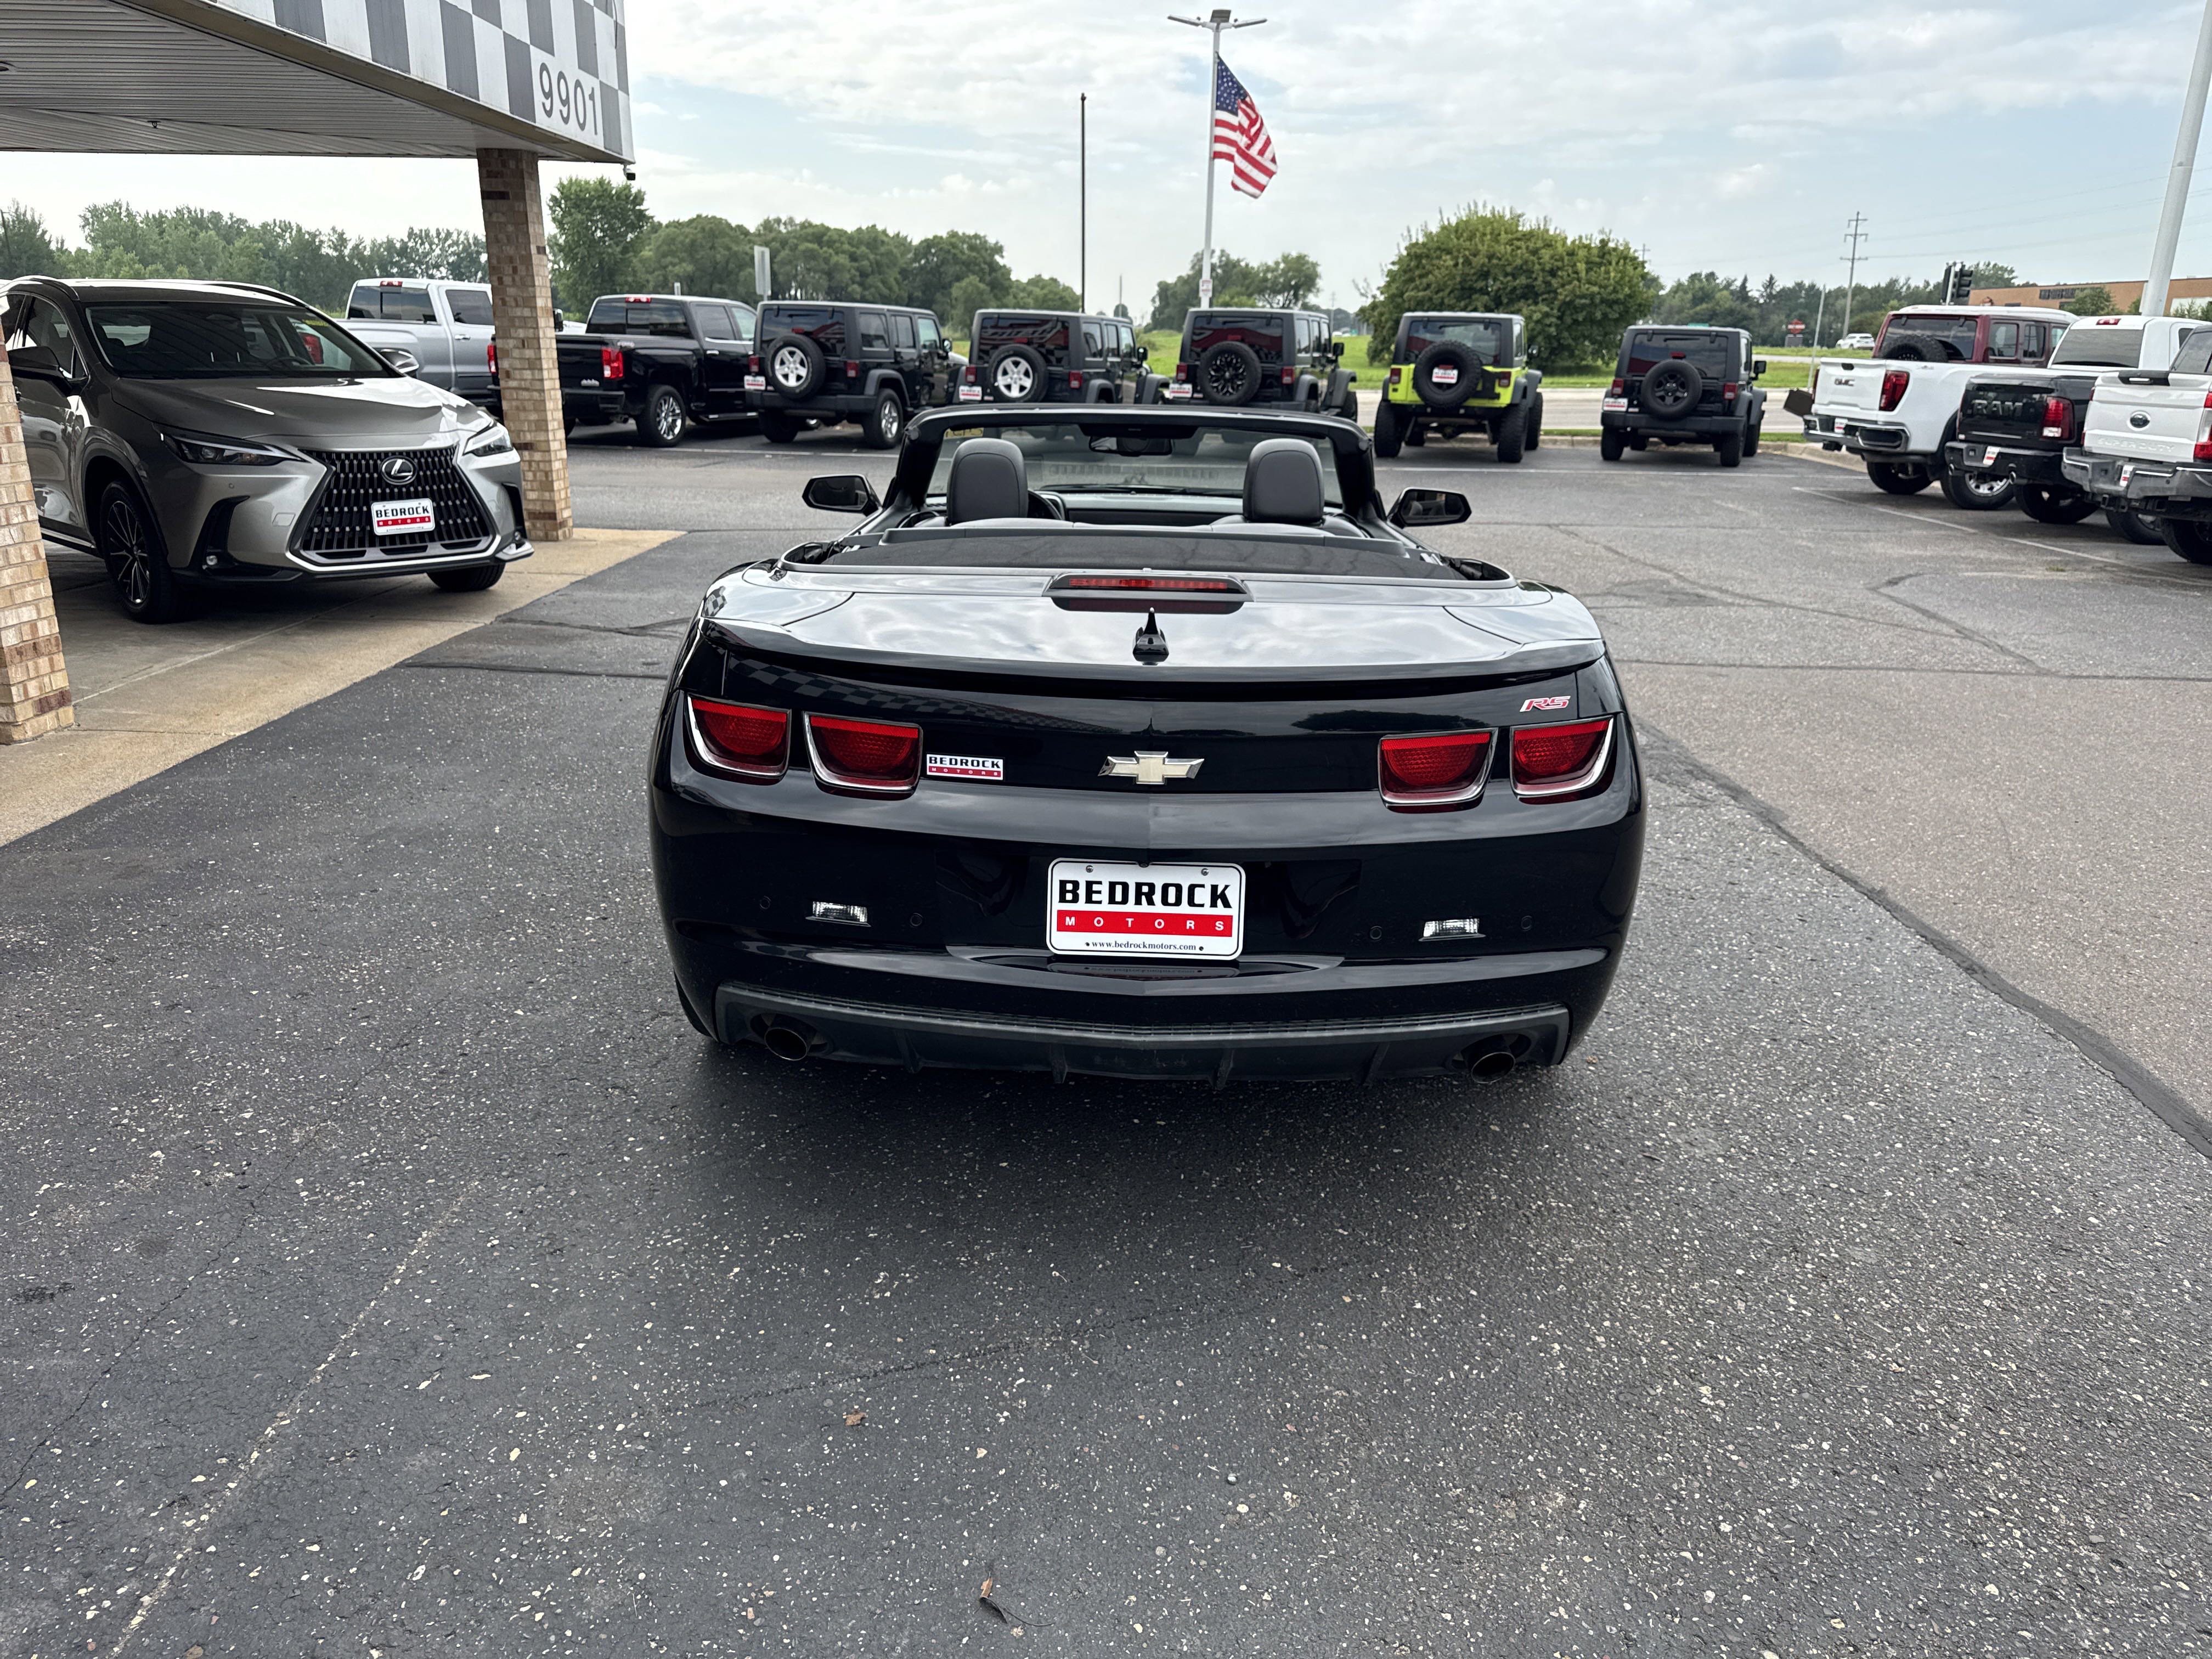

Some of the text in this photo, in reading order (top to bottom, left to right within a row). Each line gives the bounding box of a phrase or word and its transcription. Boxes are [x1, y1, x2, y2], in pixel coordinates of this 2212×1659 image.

[539, 62, 598, 136] 9901
[1972, 399, 2023, 417] RAM
[375, 505, 430, 518] BEDROCK
[1520, 696, 1571, 712] RS
[929, 756, 1001, 769] BEDROCK
[932, 768, 998, 776] MOTORS
[1058, 879, 1233, 909] BEDROCK
[1065, 916, 1224, 931] MOTORS
[1092, 940, 1197, 951] www.bedrockmotors.com
